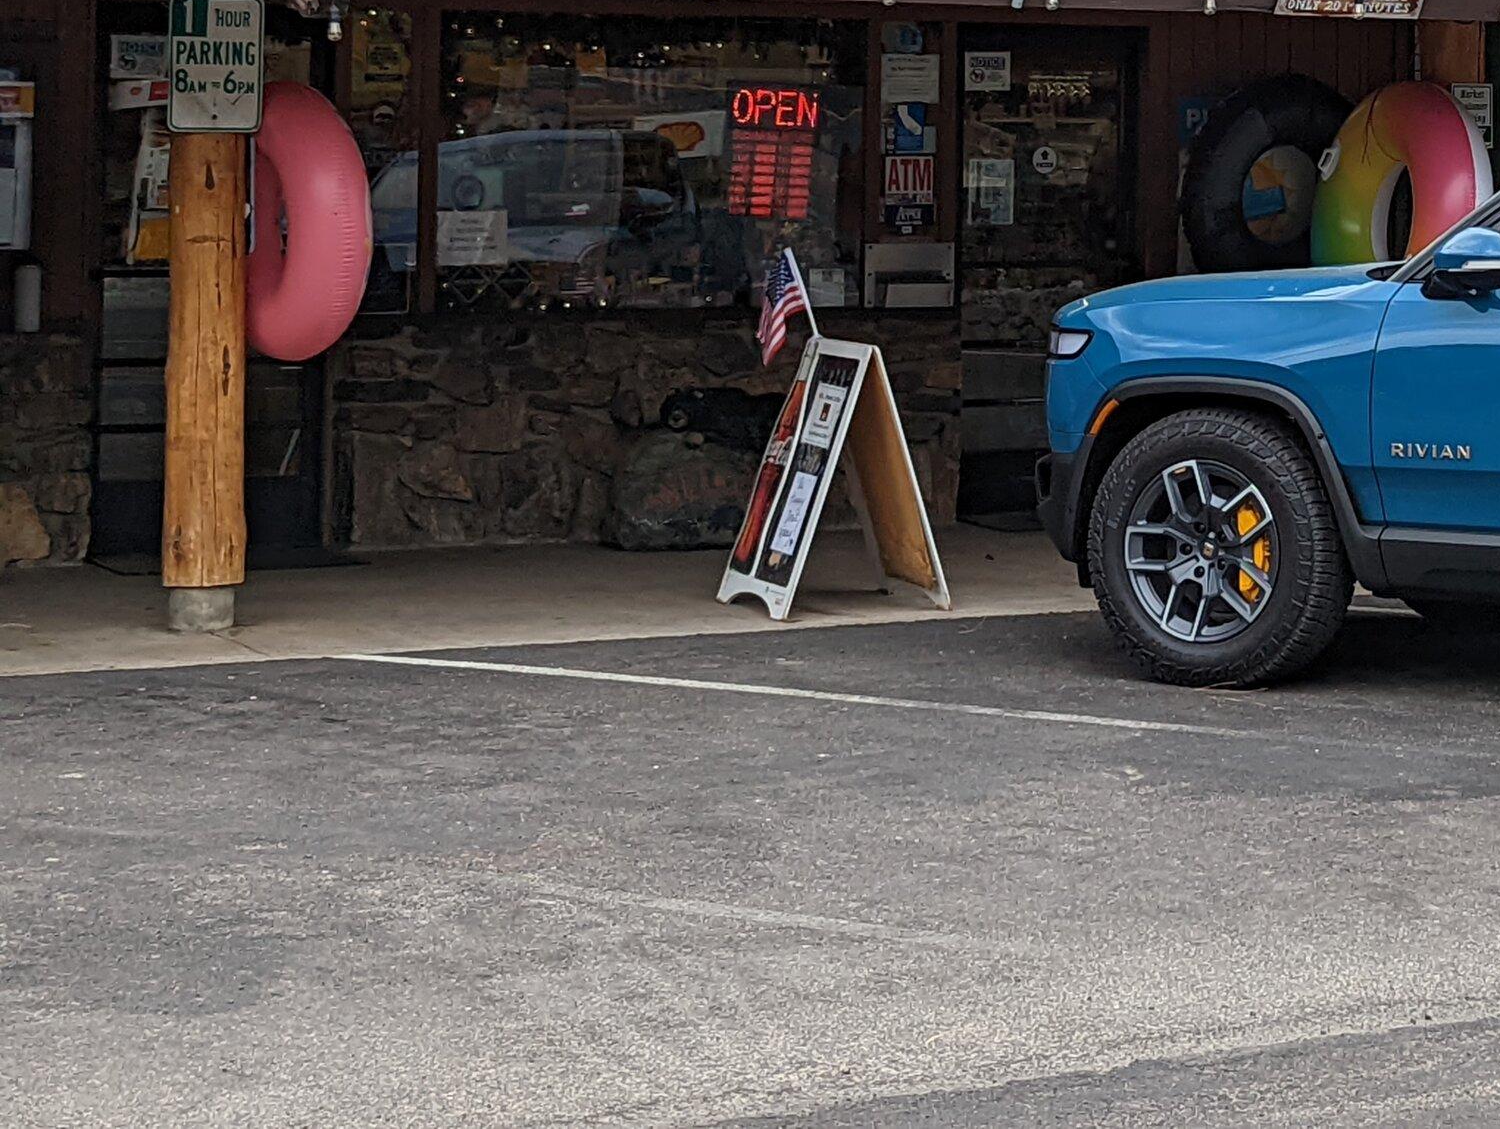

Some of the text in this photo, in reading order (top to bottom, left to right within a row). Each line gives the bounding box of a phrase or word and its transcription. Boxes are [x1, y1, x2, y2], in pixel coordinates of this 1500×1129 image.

[183, 0, 251, 33] 1 HOUR
[1323, 1, 1341, 12] 20
[175, 40, 256, 66] PARKING
[733, 88, 818, 128] OPEN
[888, 159, 932, 192] ATM
[1390, 442, 1471, 460] RIVIAN
